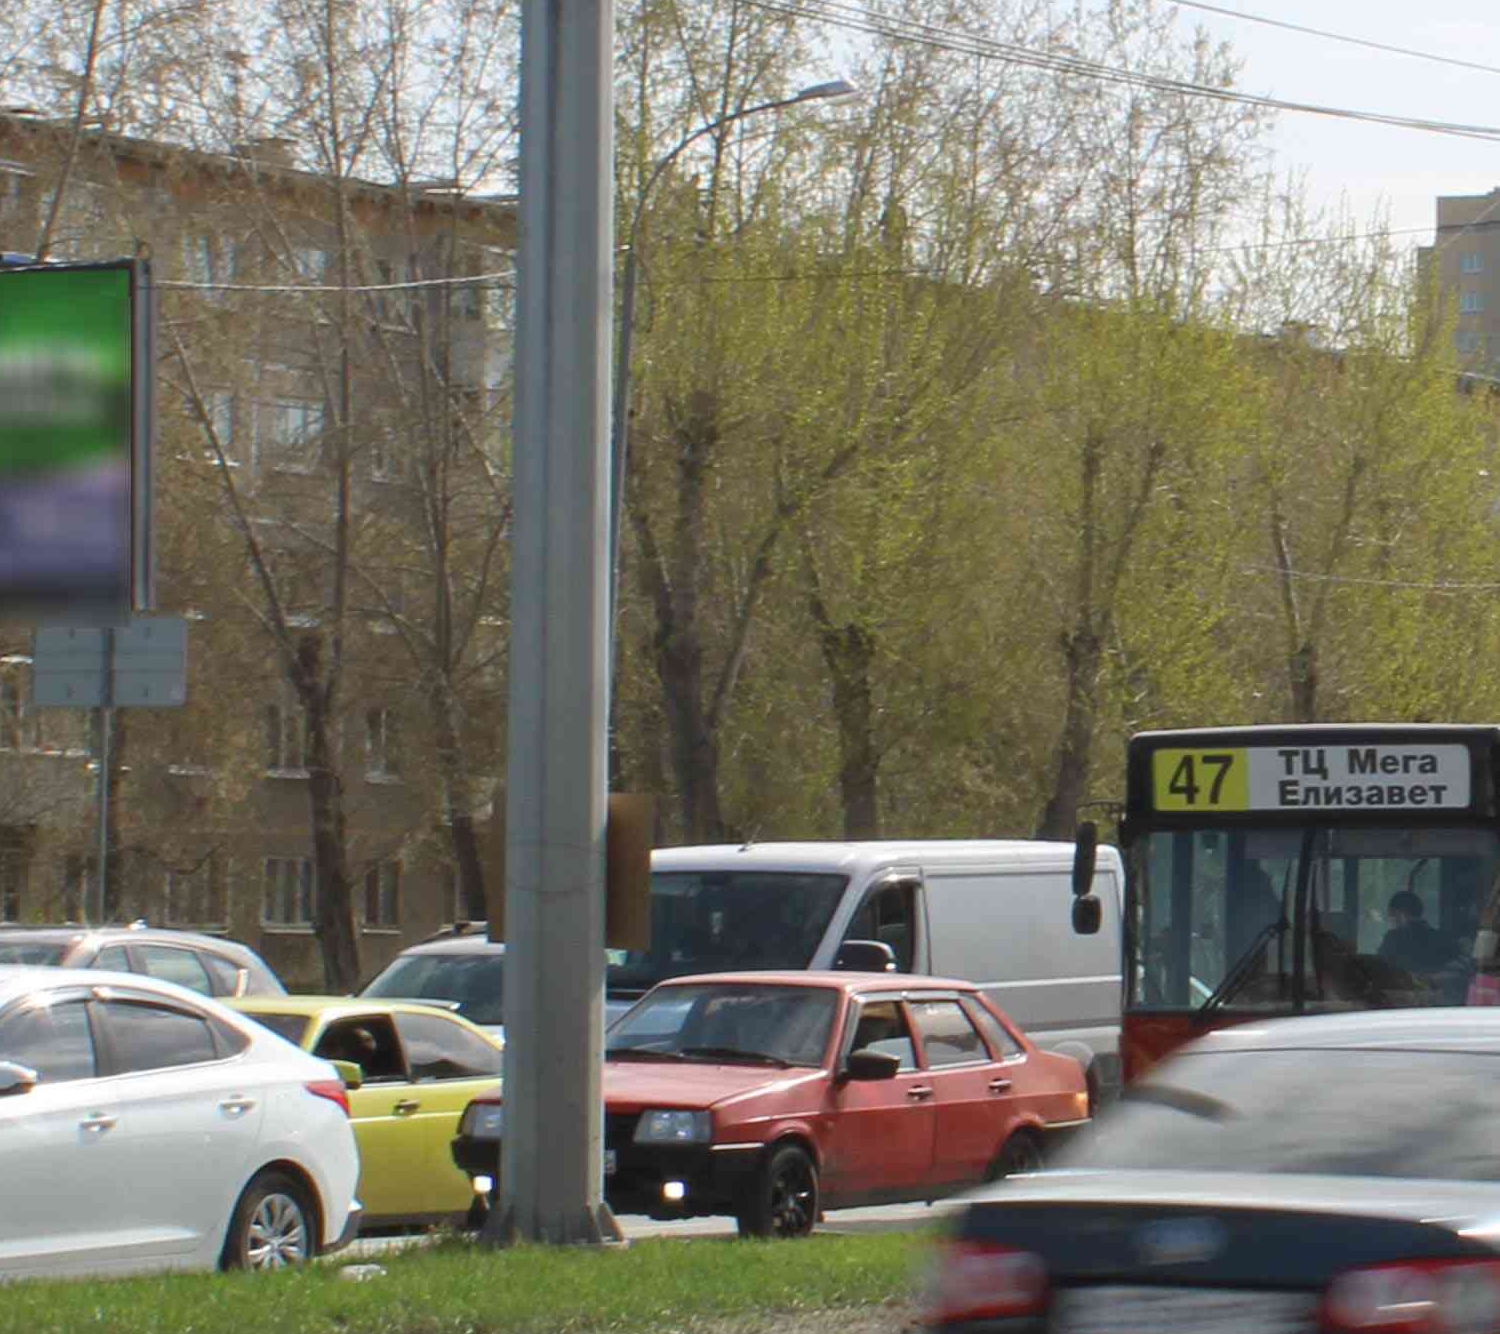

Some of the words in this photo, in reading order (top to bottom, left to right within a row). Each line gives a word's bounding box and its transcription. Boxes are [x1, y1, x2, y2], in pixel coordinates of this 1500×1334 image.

[1278, 749, 1329, 779] ТЦ
[1347, 747, 1438, 775] Мега
[1168, 754, 1235, 805] 47
[1278, 780, 1448, 807] Елизавет
